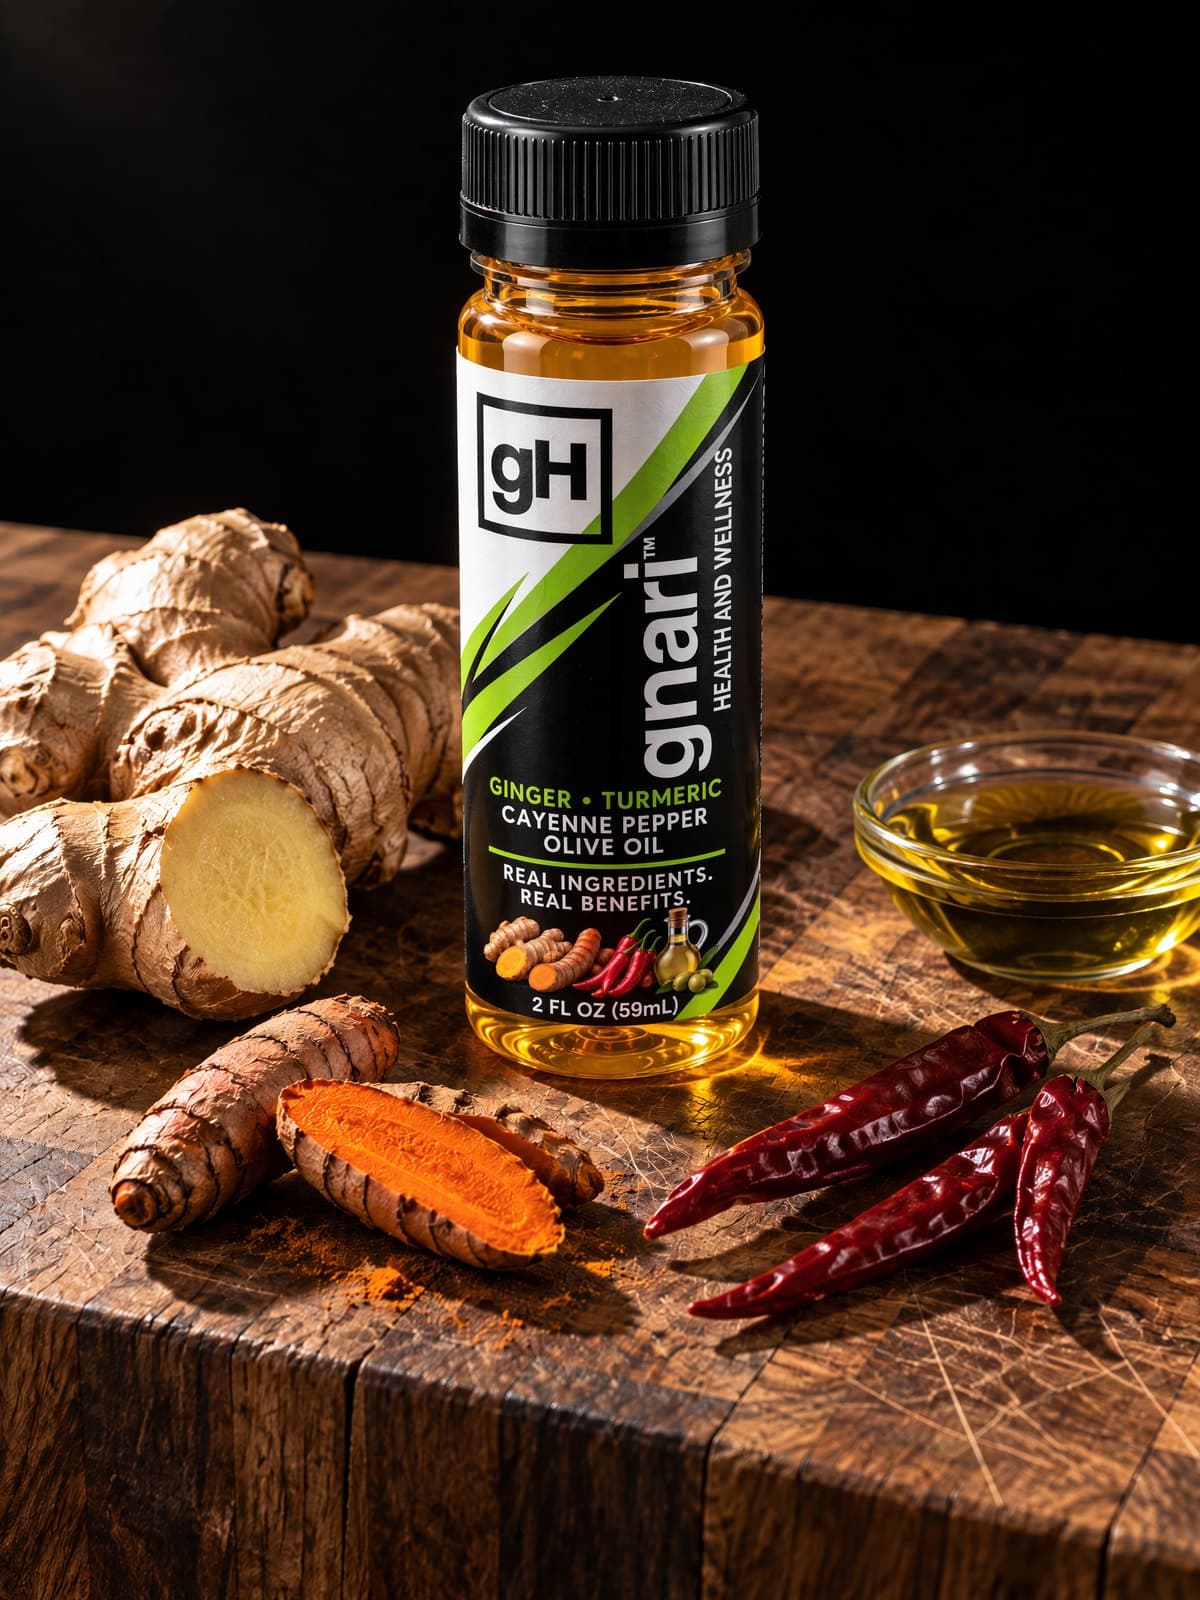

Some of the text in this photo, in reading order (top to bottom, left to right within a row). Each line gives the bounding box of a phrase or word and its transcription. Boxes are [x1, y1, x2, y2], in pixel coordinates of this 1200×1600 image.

[490, 439, 587, 515] gH
[713, 447, 733, 712] HEALTH AND WELLNESS
[489, 776, 722, 810] GINGER TURMERIC
[501, 805, 708, 834] CAYENNE PEPPER
[543, 834, 664, 856] OLIVE OIL
[503, 863, 713, 892] REAL INGREDIENTS.
[520, 888, 691, 912] REAL BENEFITS.
[531, 996, 679, 1020] 2 FL OZ (59mL)
